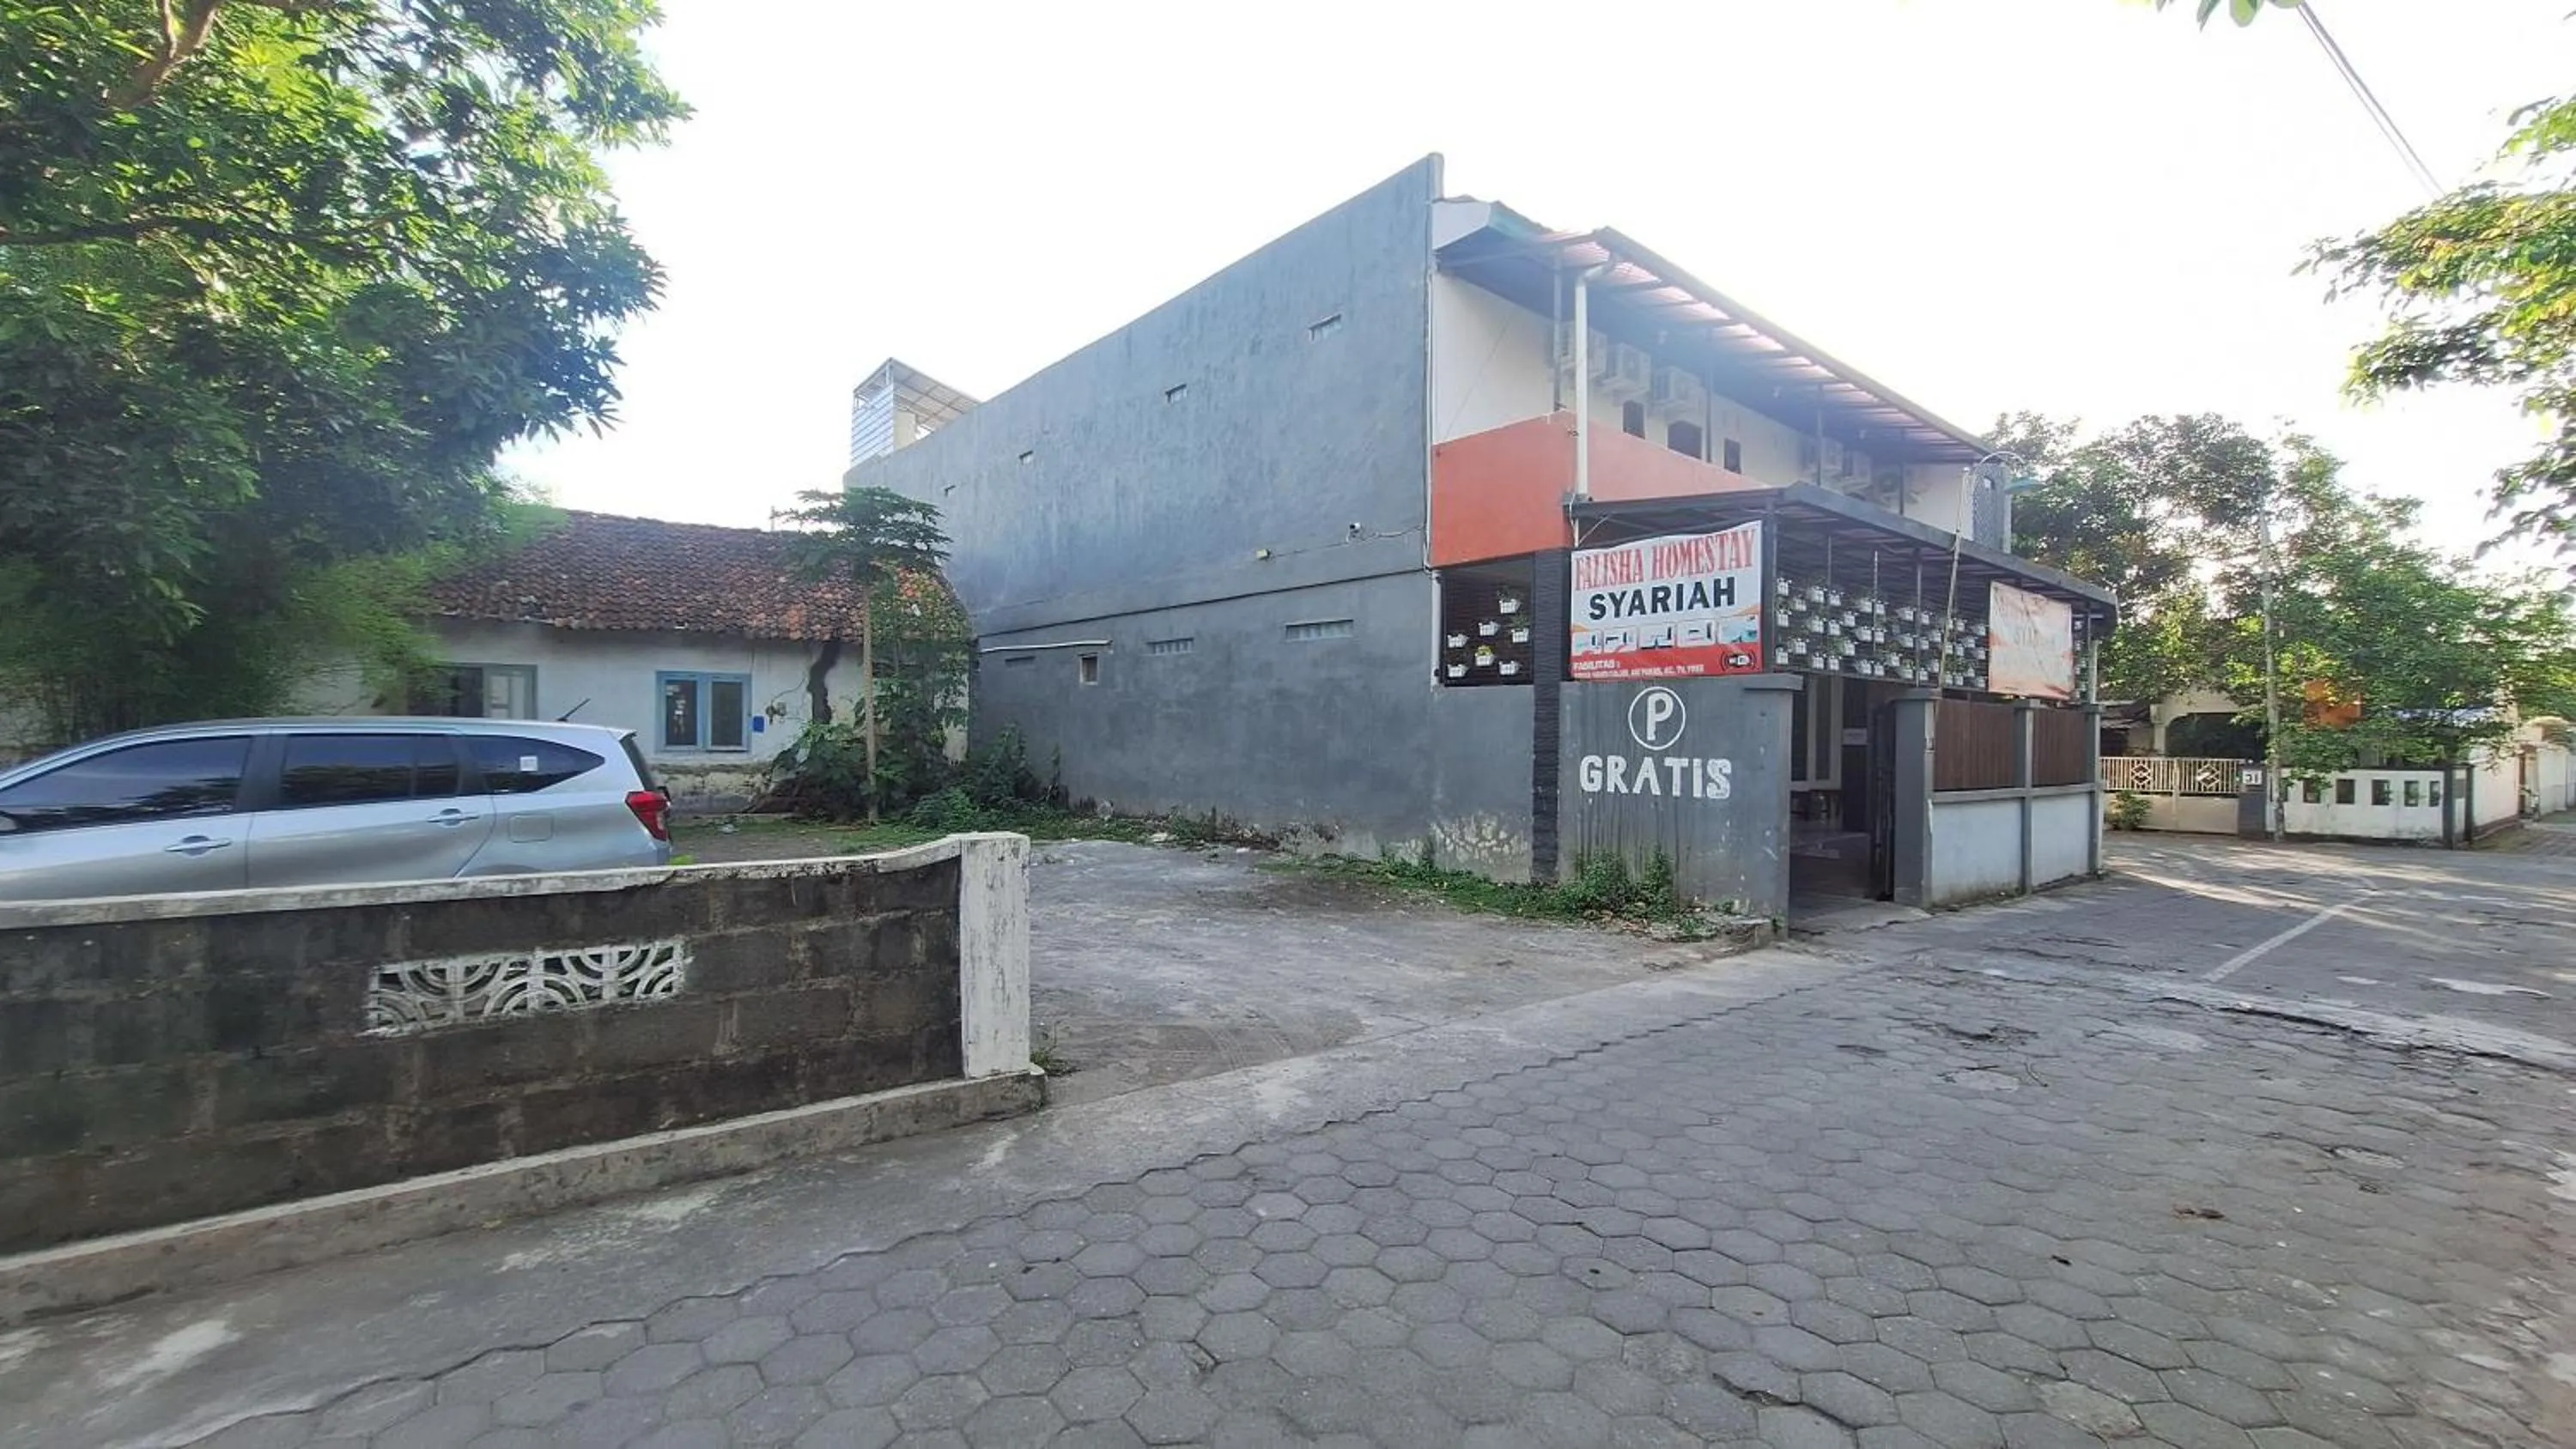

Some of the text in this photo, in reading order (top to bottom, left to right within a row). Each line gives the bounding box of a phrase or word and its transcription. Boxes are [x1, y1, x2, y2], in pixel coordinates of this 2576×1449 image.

[1576, 529, 1756, 591] FALISHA HOMESTAY
[1589, 576, 1735, 621] SYARIAH
[1647, 693, 1674, 741] P
[1579, 755, 1732, 799] GRATIS
